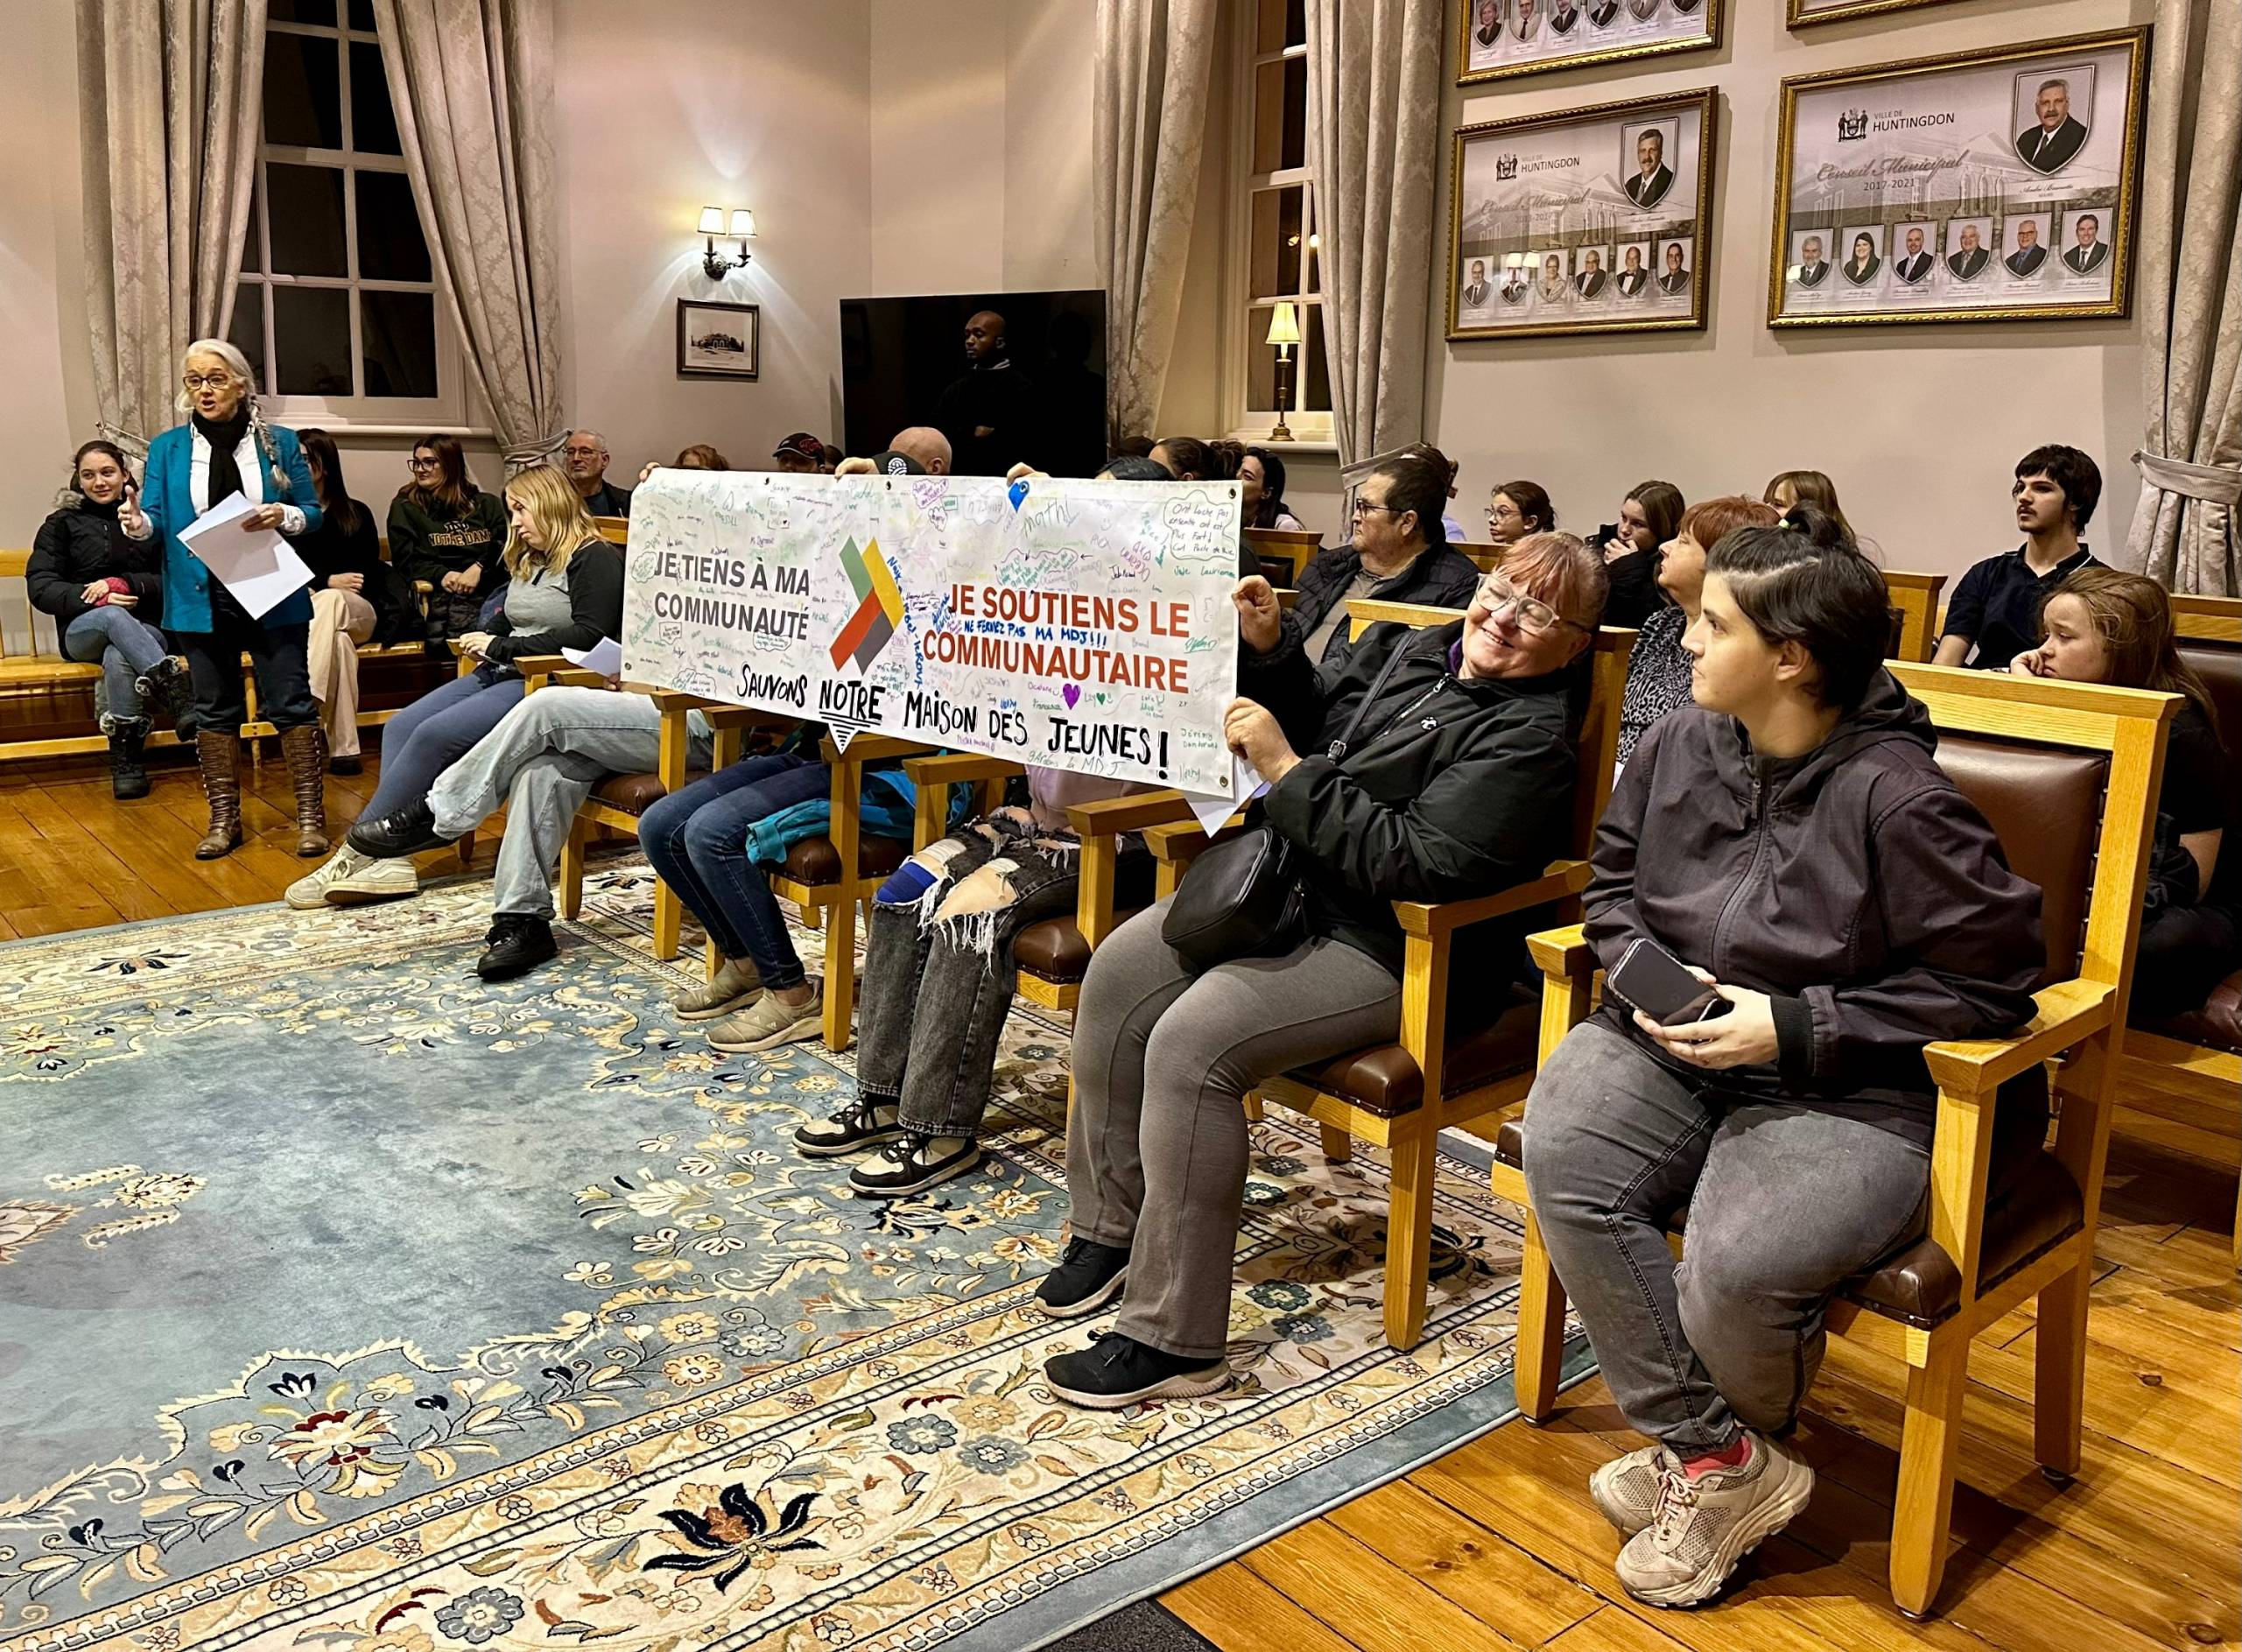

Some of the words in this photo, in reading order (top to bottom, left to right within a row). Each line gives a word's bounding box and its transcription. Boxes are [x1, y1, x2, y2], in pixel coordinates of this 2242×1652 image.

[1873, 113, 1955, 132] HUNTINGDON
[1521, 157, 1580, 173] HUNTINGDON
[1873, 149, 1970, 183] Municipal
[1863, 178, 1915, 191] 2017-2021
[465, 529, 491, 545] DAM
[654, 552, 677, 578] JE
[680, 554, 745, 587] TIENS
[750, 557, 768, 592] À
[775, 566, 810, 596] MA
[654, 591, 810, 640] COMMUNAUTÉ
[949, 584, 975, 615] JE
[982, 587, 1139, 633] SOUTIENS
[1150, 601, 1190, 638] LE
[965, 620, 974, 633] NE
[1008, 623, 1026, 637] PAS
[1036, 627, 1053, 641] MA
[923, 629, 1190, 694] COMMUNAUTAIRE
[737, 664, 808, 708] SAUVONS
[819, 679, 886, 721] NOTRE
[903, 689, 977, 735] MAISON
[989, 709, 1028, 746] DES
[1048, 717, 1169, 780] JEUNES!
